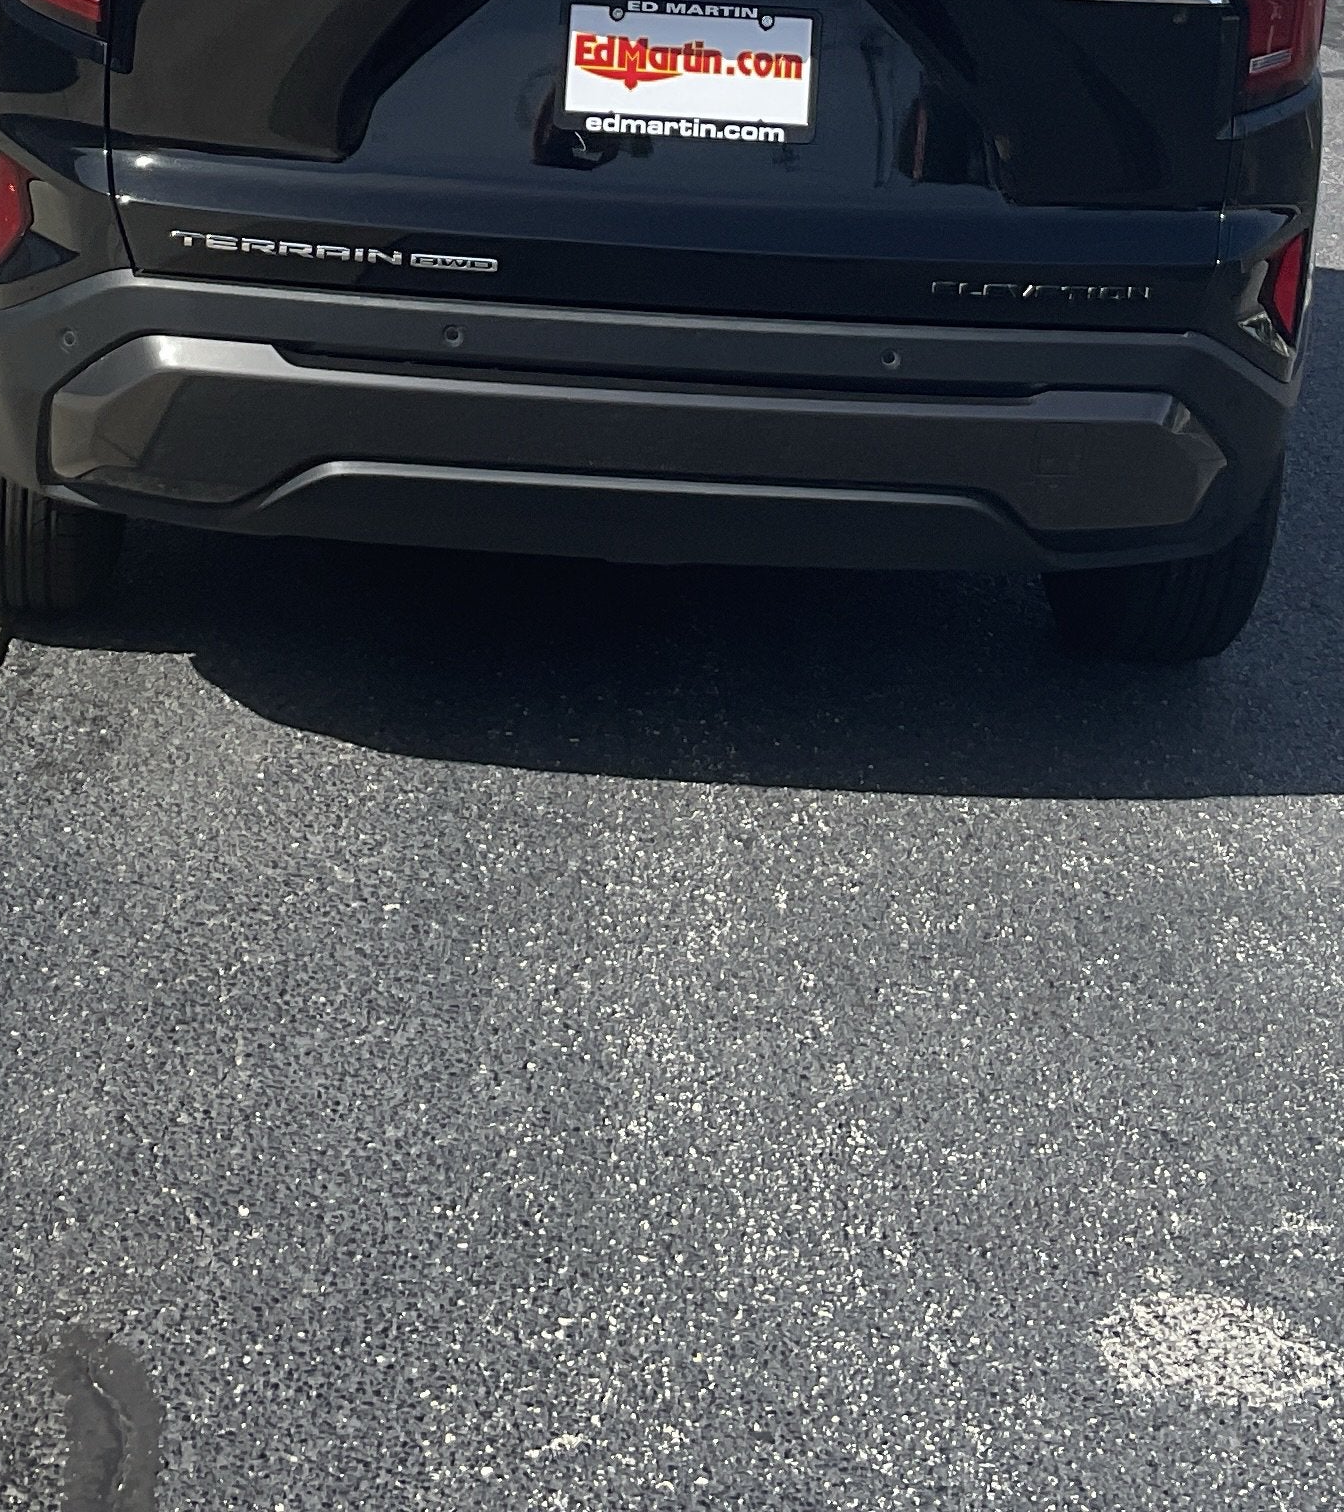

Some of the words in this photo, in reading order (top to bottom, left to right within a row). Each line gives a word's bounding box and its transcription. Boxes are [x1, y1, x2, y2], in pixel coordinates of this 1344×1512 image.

[627, 0, 658, 13] ED
[665, 3, 758, 18] MARTIN
[574, 33, 804, 81] EdMartin.com
[585, 113, 785, 142] edmartin.com
[170, 230, 402, 266] TERRAIN
[413, 254, 496, 271] AWD
